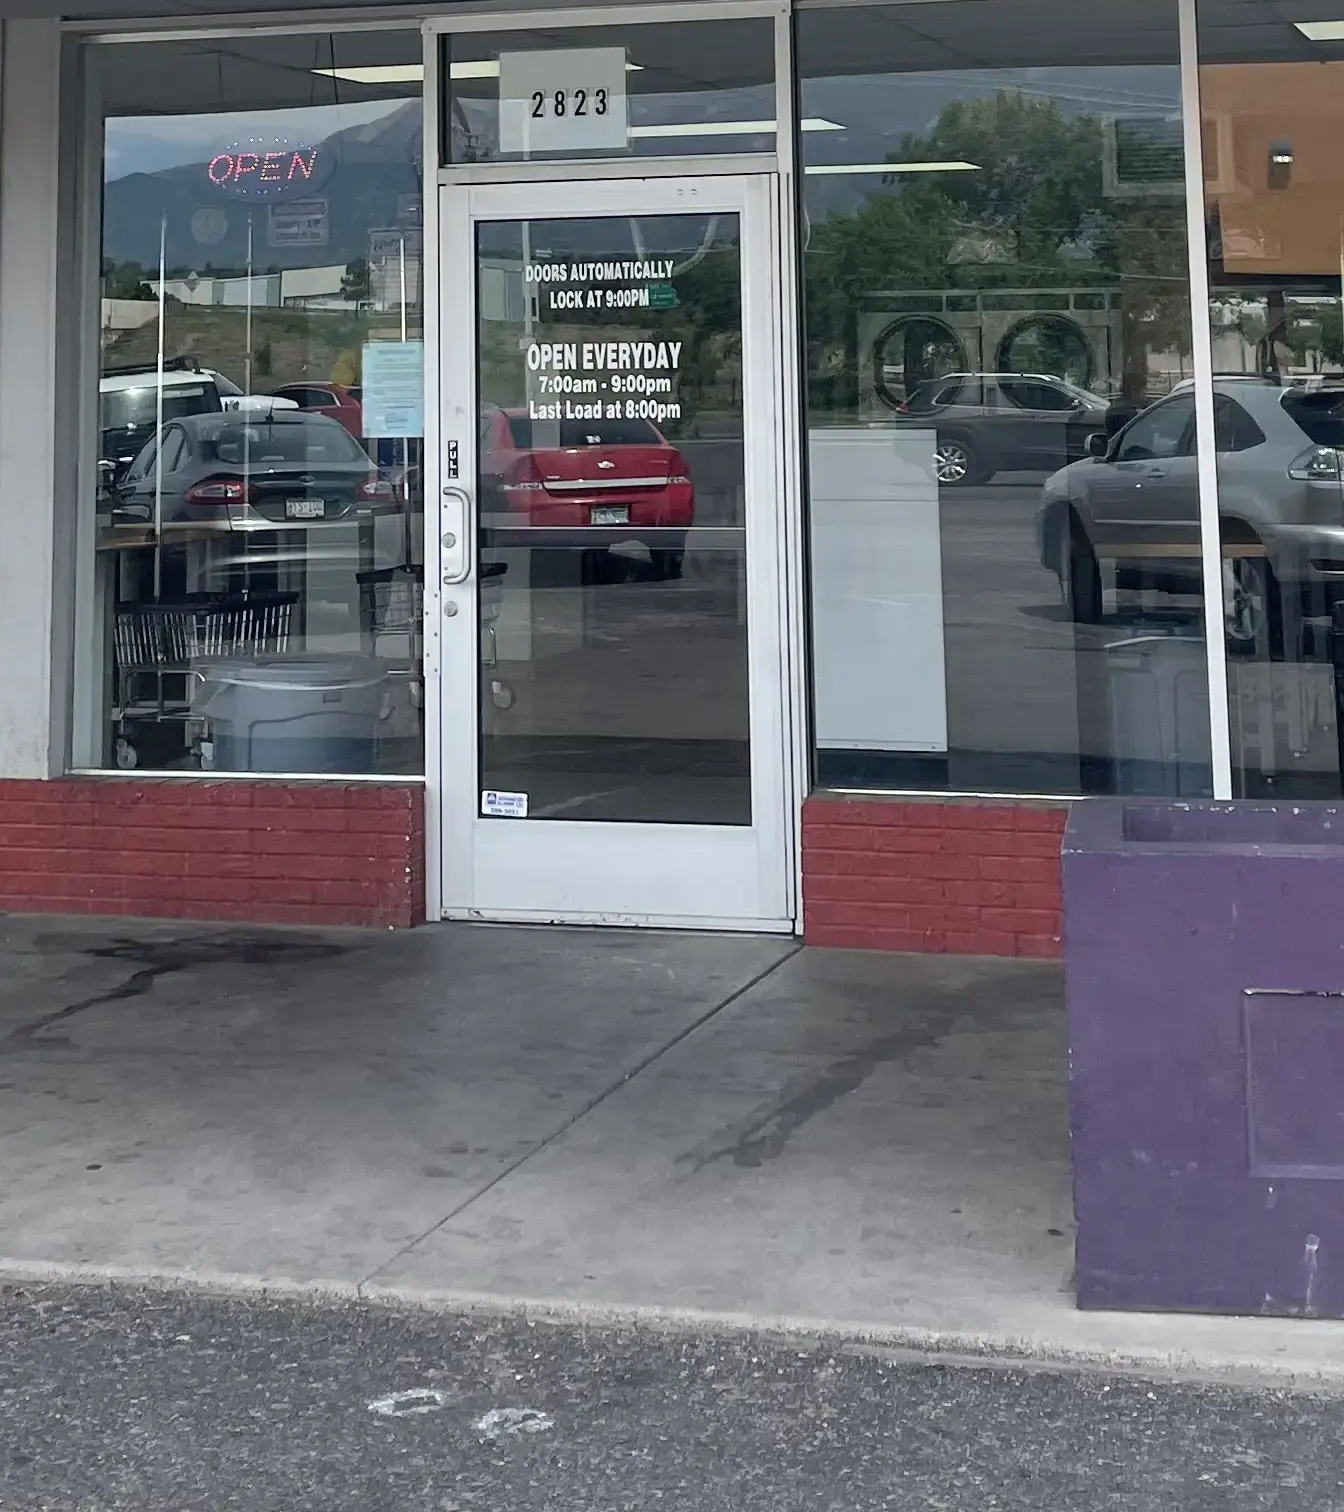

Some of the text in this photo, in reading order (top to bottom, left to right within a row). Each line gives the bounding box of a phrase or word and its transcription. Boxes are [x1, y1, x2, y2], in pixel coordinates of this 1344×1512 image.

[532, 89, 606, 118] 2823
[208, 150, 318, 184] OPEN
[525, 260, 674, 283] DOORS AUTOMATICALLY
[550, 290, 584, 309] LOCK
[586, 289, 603, 308] AT
[606, 288, 650, 308] 9:00PM
[527, 342, 682, 370] OPEN EVERYDAY
[539, 375, 597, 393] 7:00am
[611, 374, 671, 395] 9:00pm
[529, 399, 681, 423] Last Load at 8:00pm
[449, 441, 458, 478] PULL
